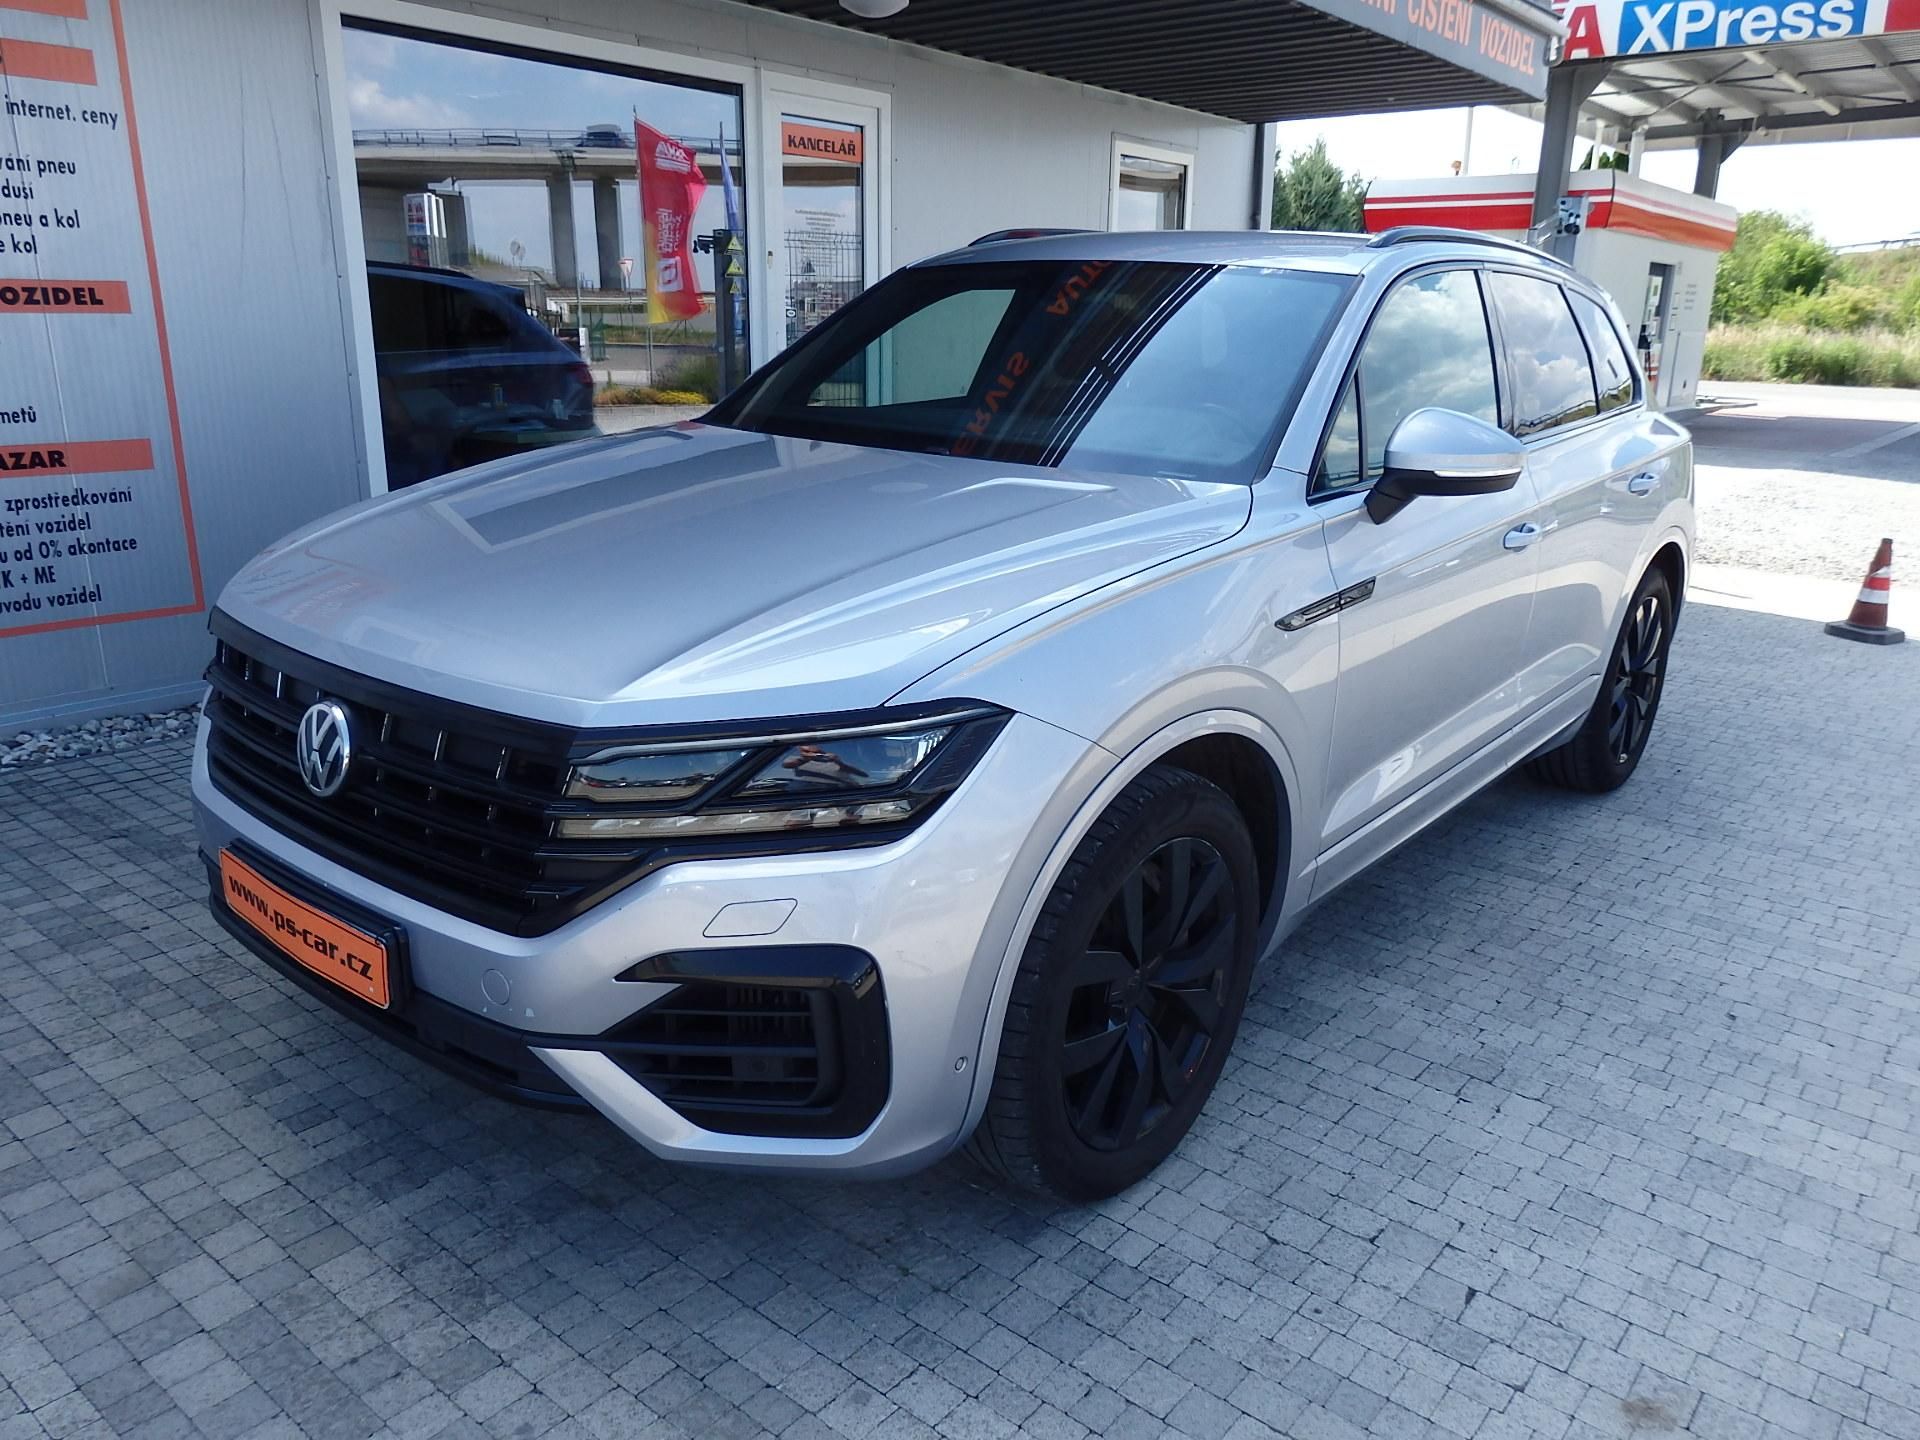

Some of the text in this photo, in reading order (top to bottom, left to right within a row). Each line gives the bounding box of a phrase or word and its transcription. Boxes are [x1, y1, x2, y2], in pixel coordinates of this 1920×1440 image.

[1479, 13, 1535, 75] VOZIDEL
[4, 93, 118, 130] internet. ceny
[787, 134, 857, 156] KANCELÁŘ
[36, 159, 77, 178] pneu
[1, 178, 34, 199] duší
[0, 207, 81, 228] neu a kol
[10, 233, 38, 255] kol
[5, 487, 133, 516] zprostředkování
[35, 512, 92, 534] vozidel
[14, 542, 34, 562] od
[39, 540, 63, 559] 0%
[68, 537, 138, 556] akontace
[33, 565, 57, 584] ME
[46, 583, 103, 608] vozidel
[228, 875, 373, 981] www.ps-car.cz
